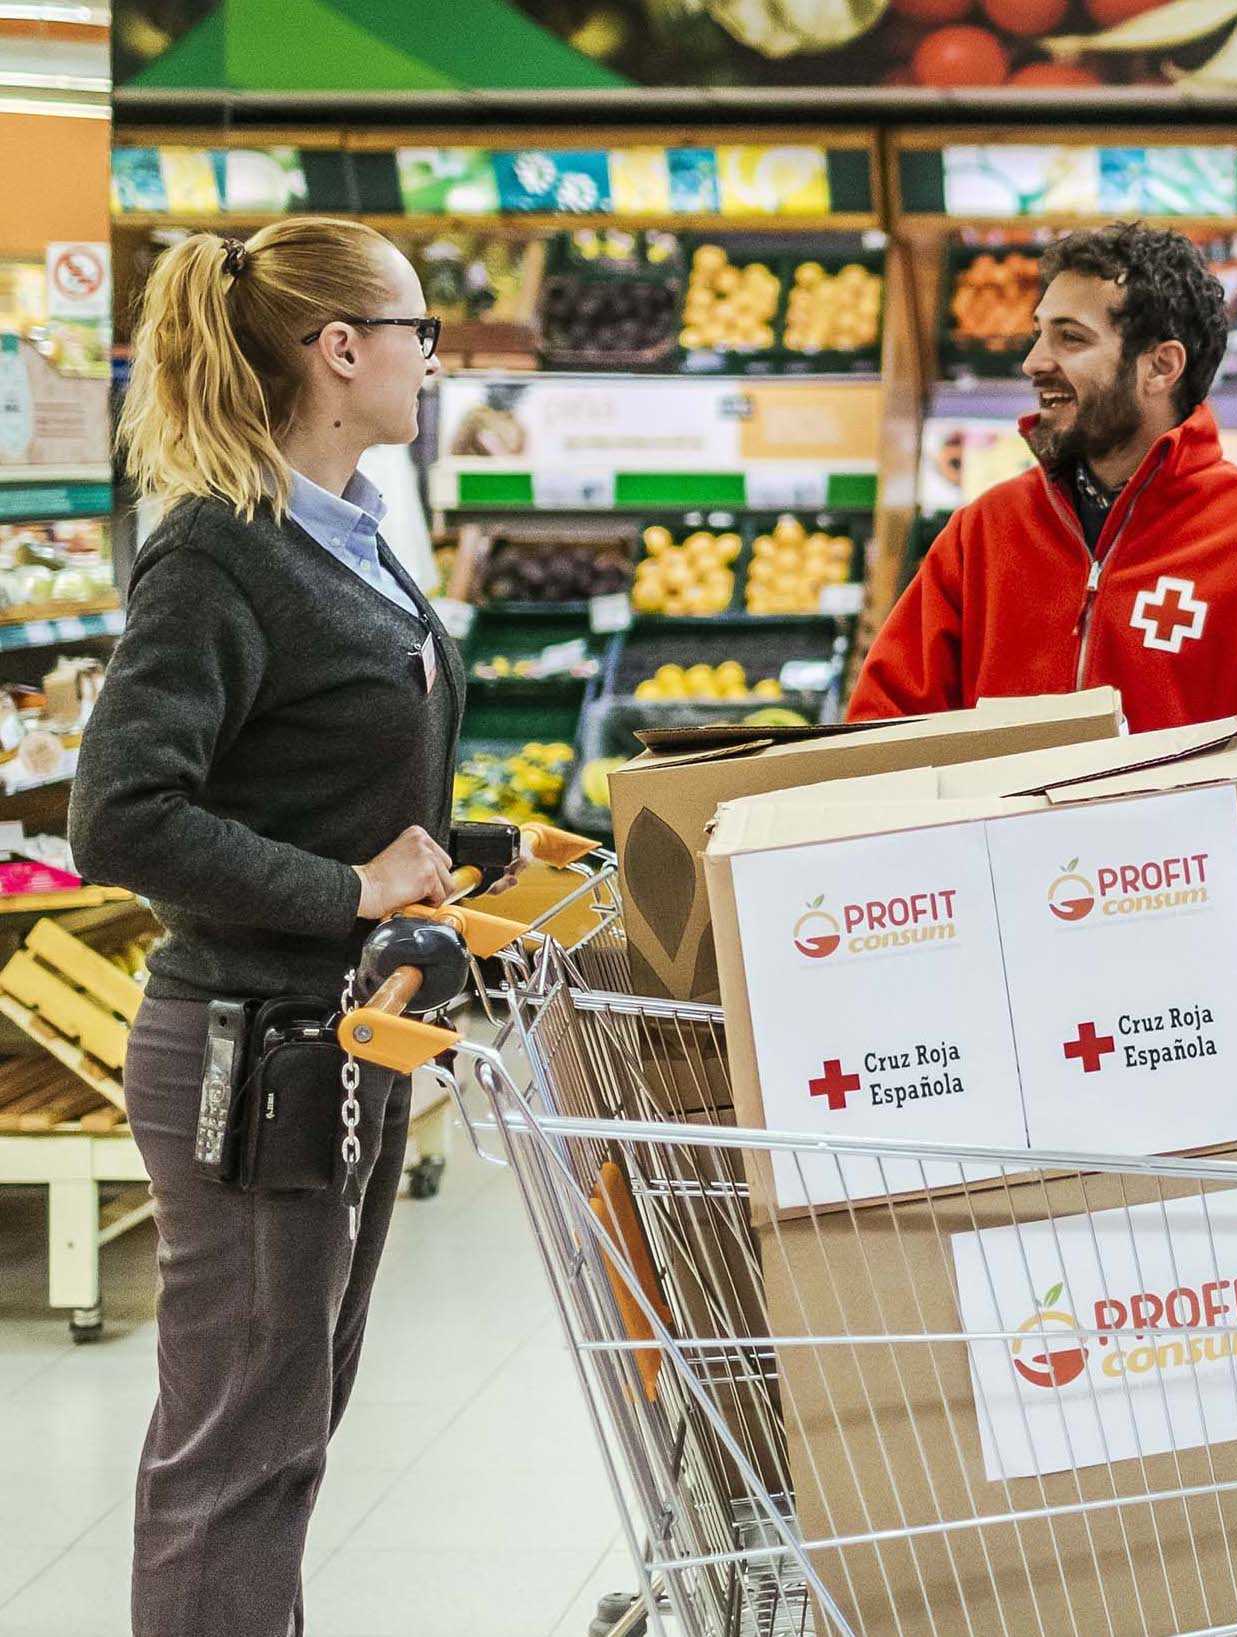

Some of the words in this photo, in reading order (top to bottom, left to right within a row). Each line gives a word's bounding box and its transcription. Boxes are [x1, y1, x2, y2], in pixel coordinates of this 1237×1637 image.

[1098, 853, 1209, 896] PROFIT
[844, 889, 957, 933] PROFIT
[1102, 886, 1208, 917] consum
[847, 921, 957, 955] consum
[1117, 1014, 1164, 1036] Cruz
[1168, 1004, 1214, 1030] Roja
[864, 1052, 911, 1074] Cruz
[915, 1041, 961, 1067] Roja
[1123, 1034, 1217, 1069] Española
[869, 1072, 964, 1108] Española
